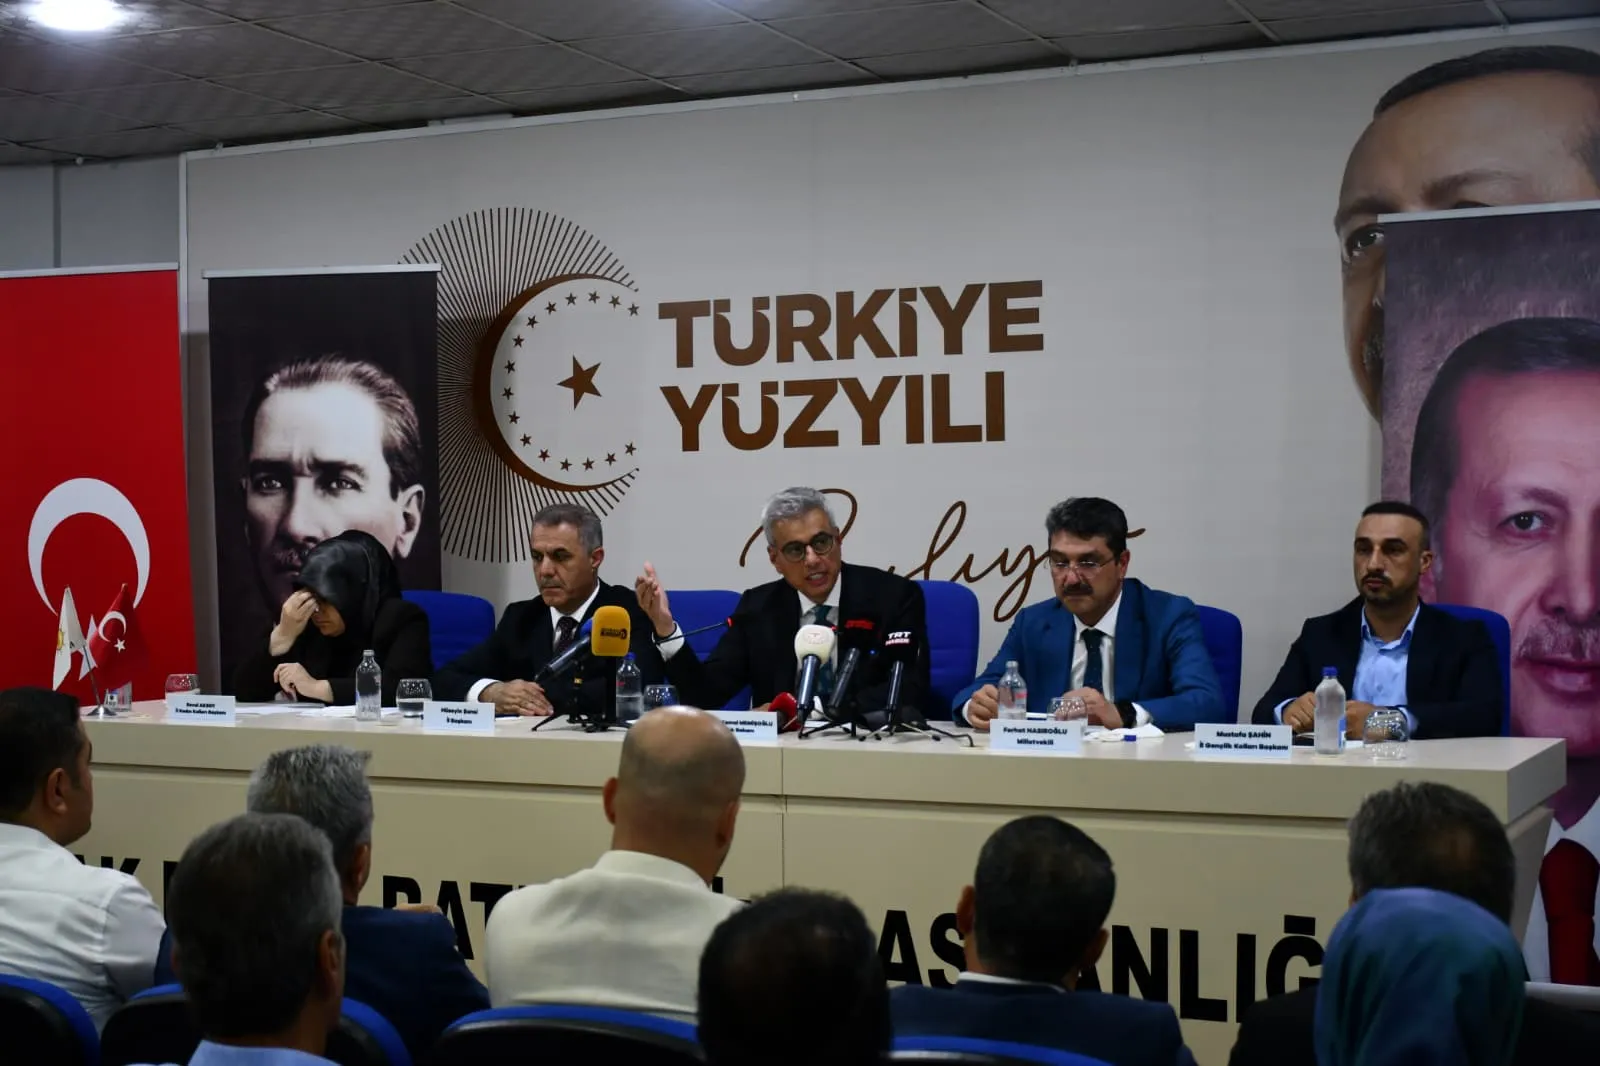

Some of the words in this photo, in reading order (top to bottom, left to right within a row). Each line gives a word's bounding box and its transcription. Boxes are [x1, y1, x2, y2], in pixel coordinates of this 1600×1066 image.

[658, 280, 1044, 368] TÜRKİYE
[659, 371, 1005, 452] YÜZYILI
[888, 631, 911, 640] TRT
[1216, 730, 1247, 739] Mustafa
[1248, 729, 1272, 739] ŞAHİN
[1205, 742, 1233, 751] Gençlik
[1234, 743, 1257, 751] Kolları
[1259, 743, 1289, 753] Başkanı
